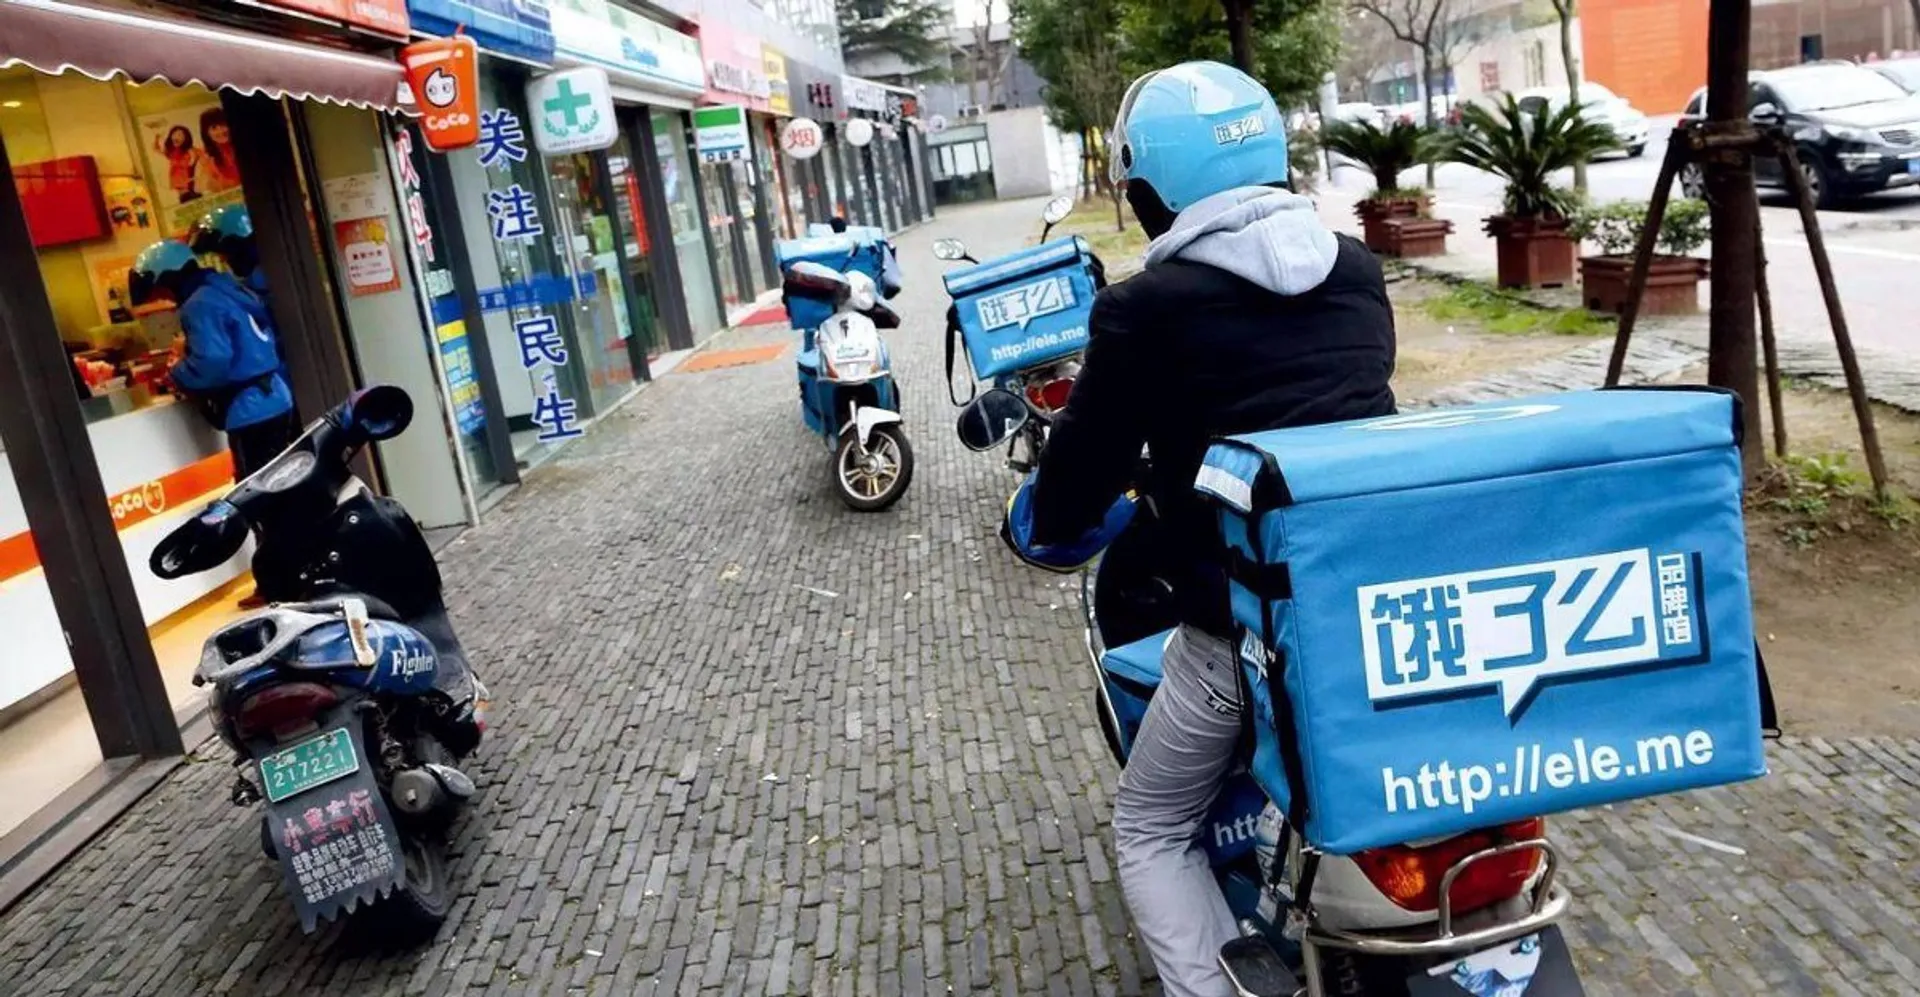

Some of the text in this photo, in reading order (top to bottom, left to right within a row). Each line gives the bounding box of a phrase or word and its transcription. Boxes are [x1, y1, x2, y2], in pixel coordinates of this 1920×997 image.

[788, 127, 815, 149] 烟
[981, 284, 1058, 326] 饿了么
[991, 327, 1086, 360] http://ele.me
[1656, 553, 1692, 645] 品牌馆
[1370, 559, 1648, 686] 饿了么
[1382, 729, 1715, 815] http://ele.me
[1213, 813, 1262, 848] htt
